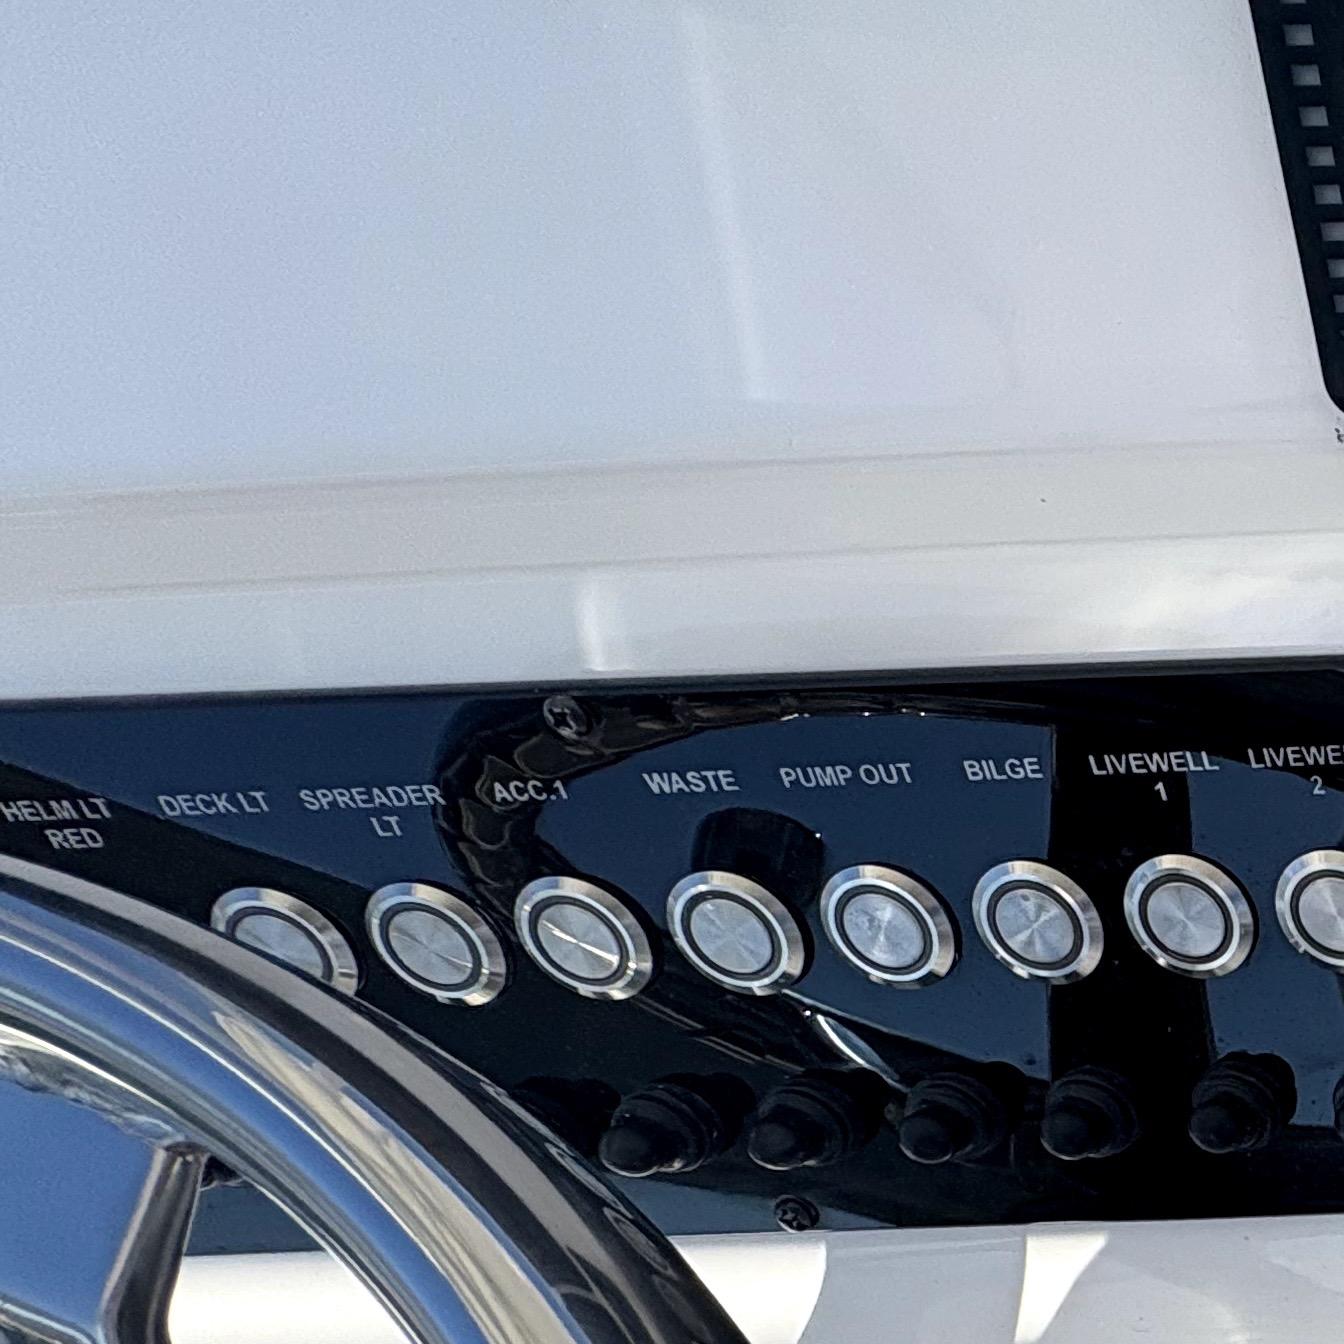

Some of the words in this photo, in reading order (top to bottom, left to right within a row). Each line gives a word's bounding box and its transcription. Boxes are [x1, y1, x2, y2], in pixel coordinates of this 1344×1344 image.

[964, 758, 1043, 780] BILGE
[1089, 751, 1219, 775] LIVEWELL
[642, 770, 739, 793] WASTE
[780, 766, 852, 788] PUMP
[860, 763, 911, 784] OUT
[1311, 776, 1326, 794] 2
[300, 785, 445, 810] SPREADER
[494, 780, 568, 801] ACC.1
[1155, 782, 1167, 800] 1
[1, 800, 79, 822] HELM
[79, 797, 112, 819] LT
[157, 793, 239, 817] DECK
[236, 791, 270, 813] LT
[370, 816, 401, 836] LT
[45, 828, 103, 848] RED
